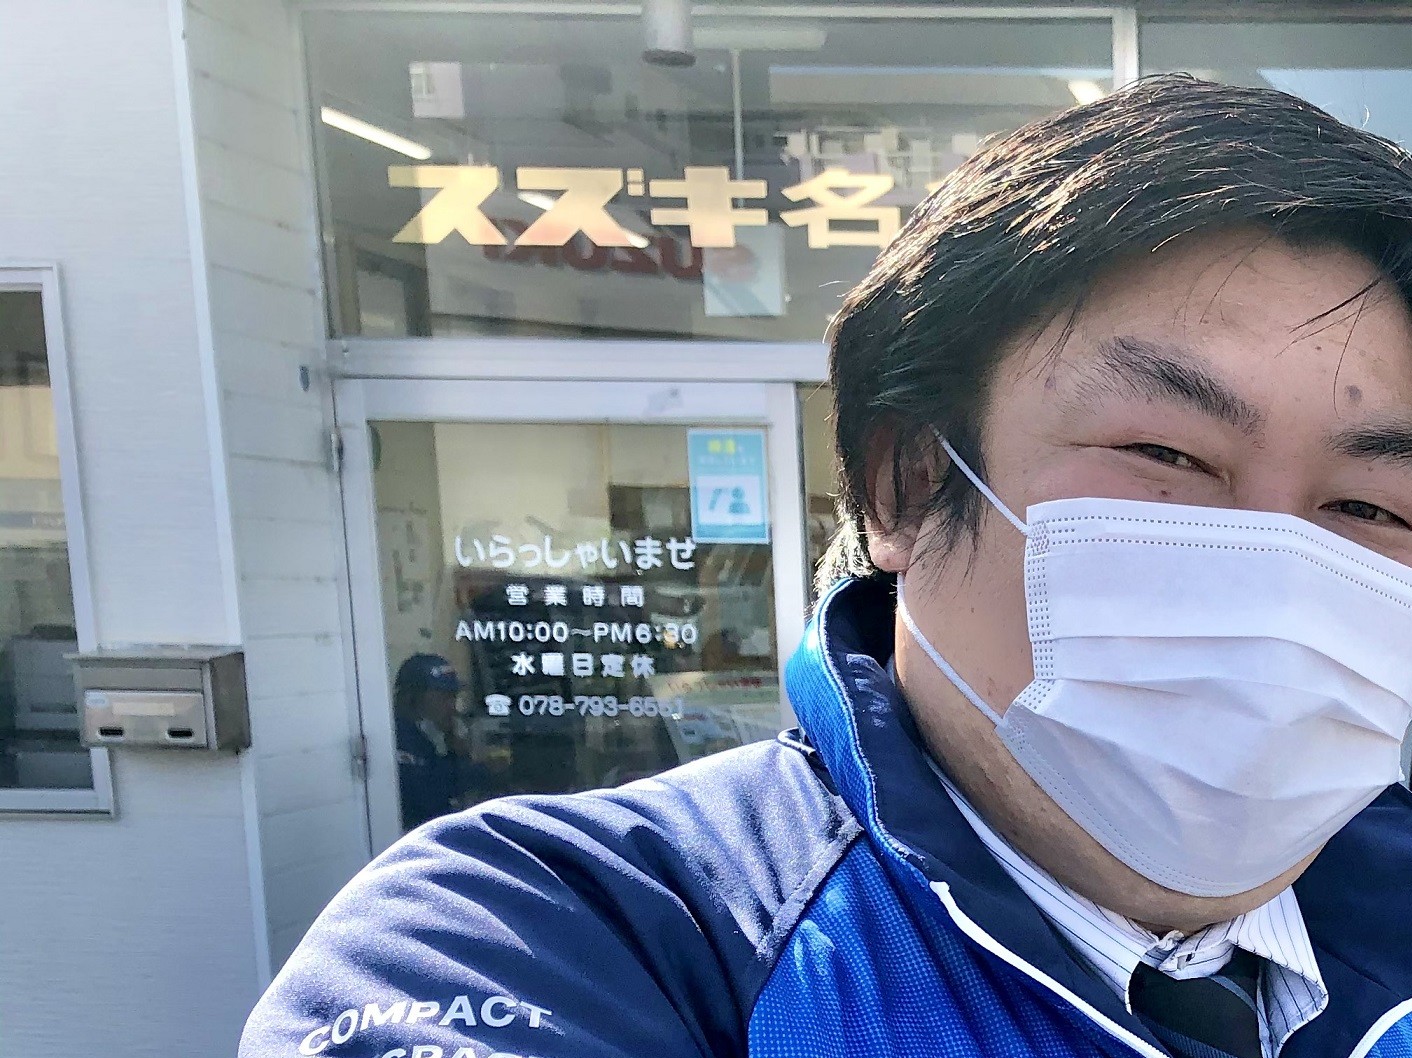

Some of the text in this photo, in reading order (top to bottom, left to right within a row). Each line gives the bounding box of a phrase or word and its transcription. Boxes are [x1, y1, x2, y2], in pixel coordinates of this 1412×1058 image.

[455, 535, 697, 570] いらっしゃいませ
[506, 584, 645, 607] 営業時間
[511, 652, 656, 678] 水曜日定休
[299, 995, 552, 1056] COMPACT
